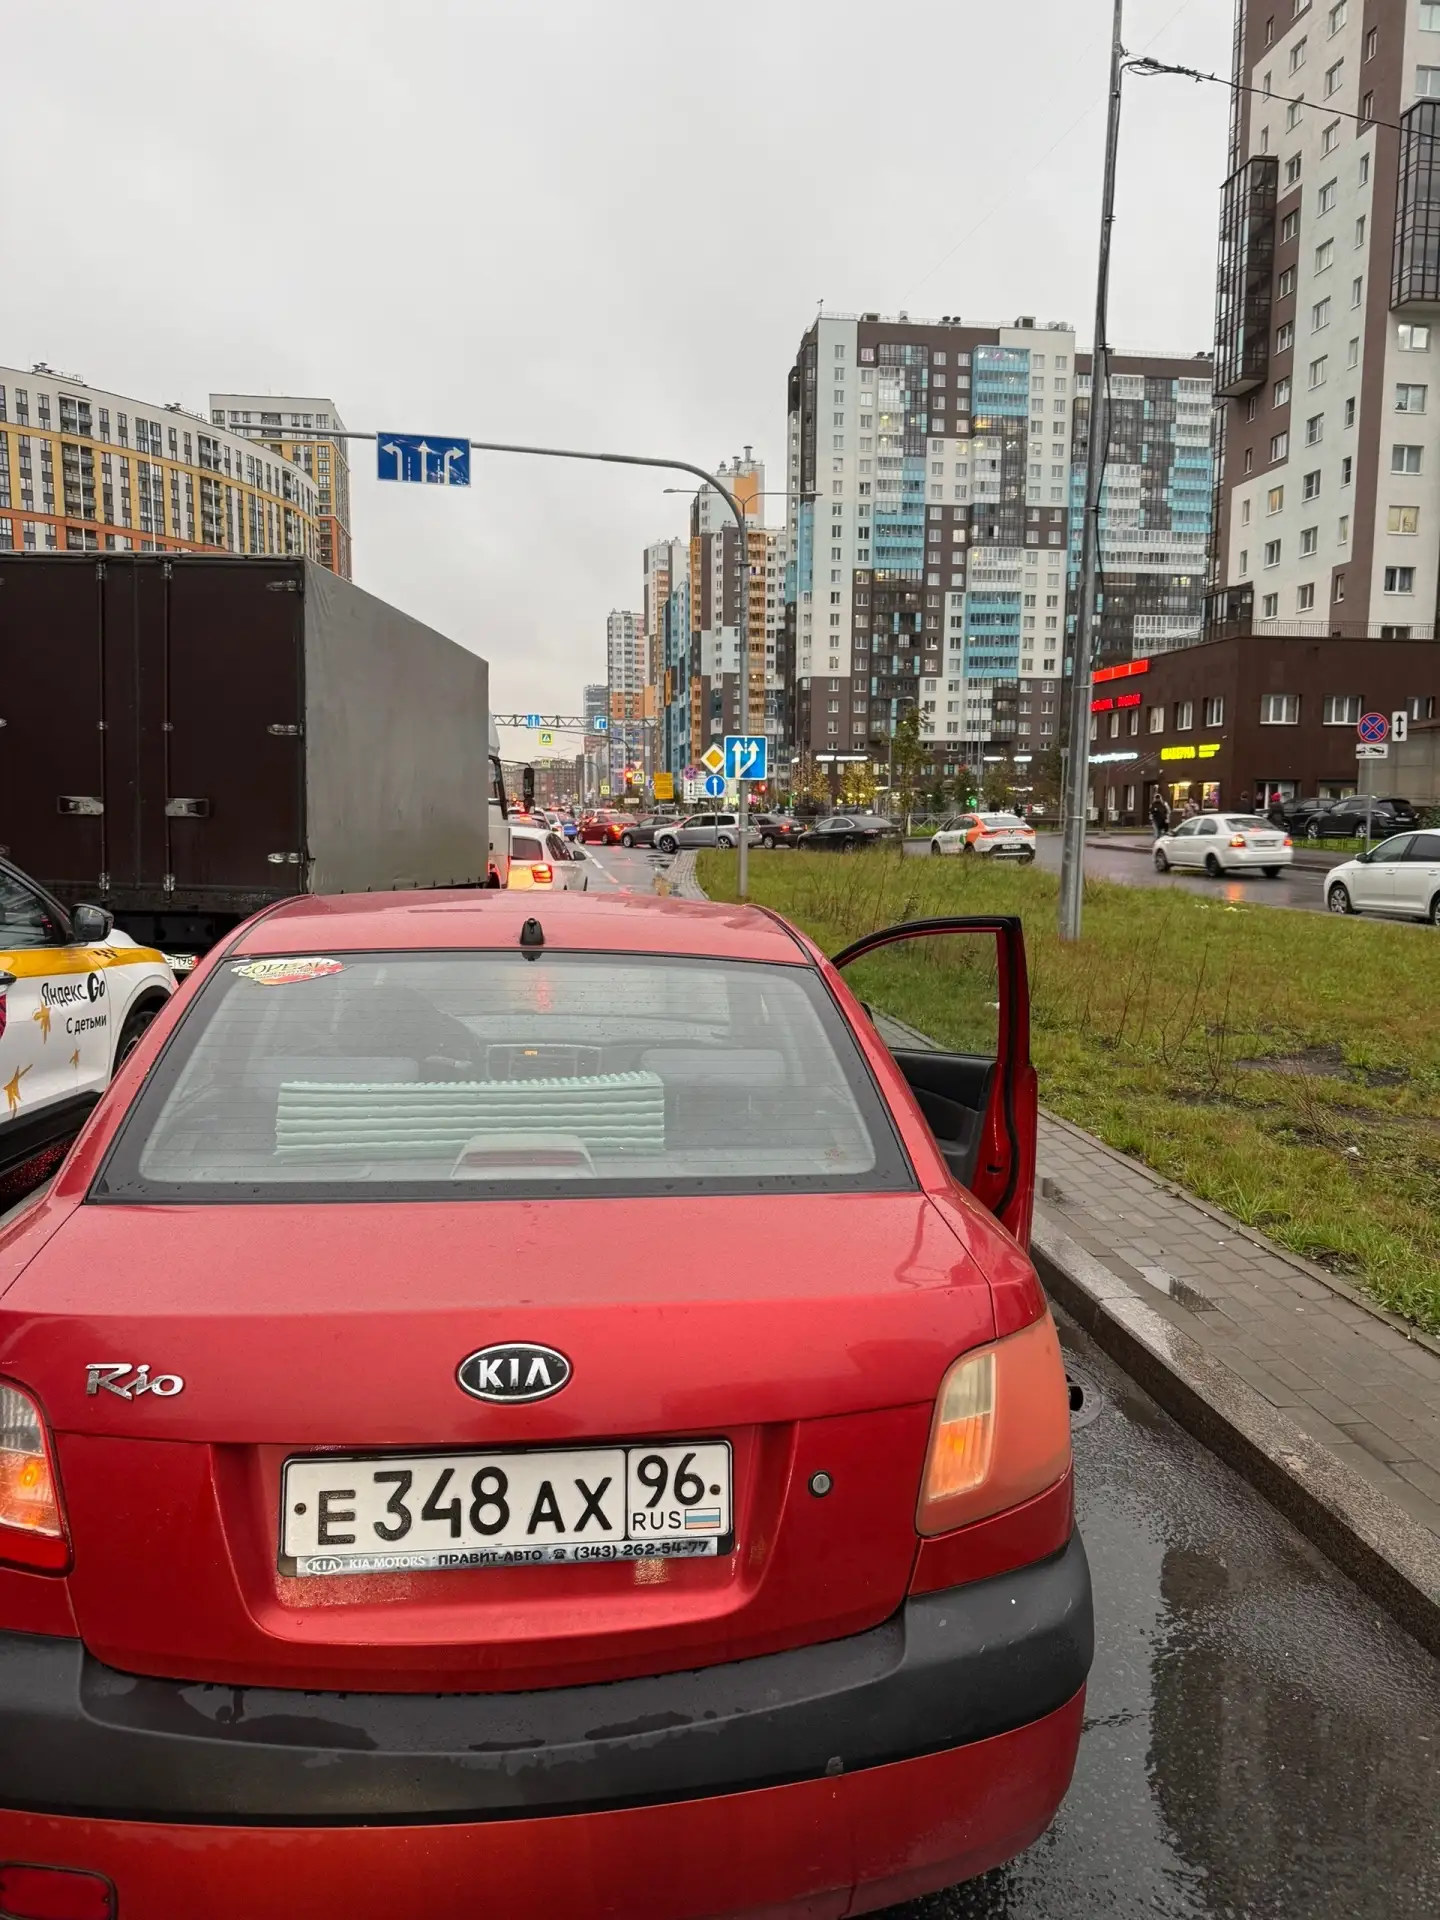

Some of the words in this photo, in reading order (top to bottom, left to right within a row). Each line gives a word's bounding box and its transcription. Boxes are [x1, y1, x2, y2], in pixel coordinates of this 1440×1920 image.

[41, 982, 87, 1007] Яндекс
[87, 972, 106, 1003] Go
[66, 1017, 73, 1034] С
[74, 1014, 107, 1035] детьми
[85, 1363, 184, 1400] Rio
[478, 1357, 553, 1389] KIA
[637, 1453, 705, 1508] 96
[632, 1511, 682, 1531] RUS
[311, 1560, 337, 1571] KIA
[350, 1559, 369, 1569] KIA
[374, 1556, 426, 1569] MOTORS
[438, 1550, 543, 1565] ПРАВИТ-АВТО
[574, 1545, 617, 1560] (343)
[622, 1541, 710, 1557] 262-54-77
